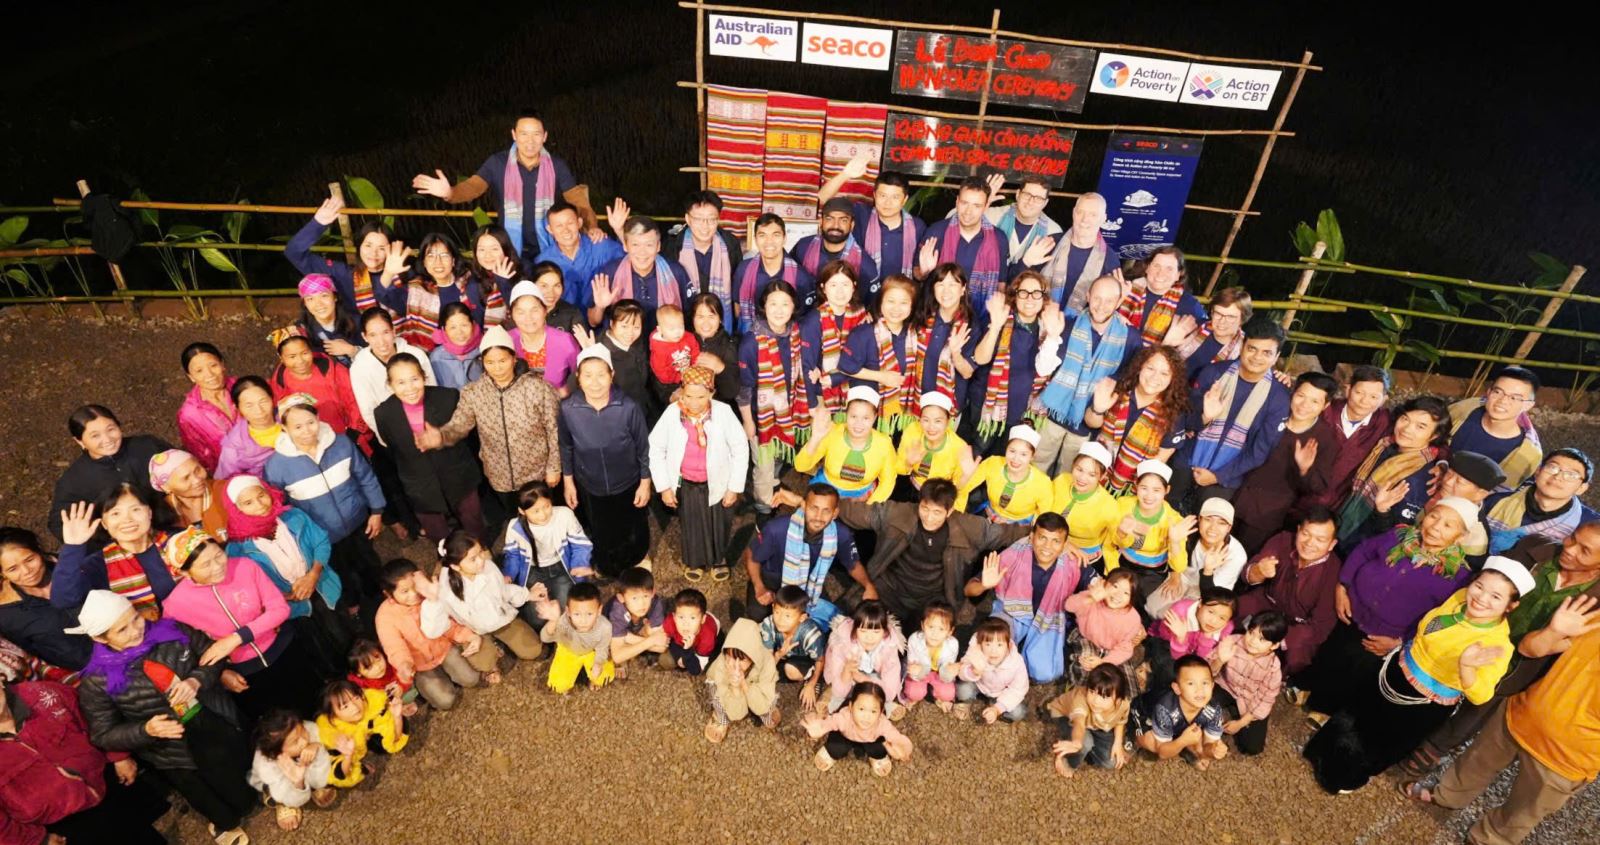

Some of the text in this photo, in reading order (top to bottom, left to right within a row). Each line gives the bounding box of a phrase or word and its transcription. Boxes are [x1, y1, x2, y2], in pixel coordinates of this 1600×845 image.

[715, 18, 793, 35] Australian
[715, 32, 742, 46] AID
[808, 34, 886, 58] seaco
[1133, 67, 1171, 81] Action
[1130, 78, 1178, 94] Poverty
[1226, 78, 1270, 92] Action
[1222, 92, 1267, 102] on CBT
